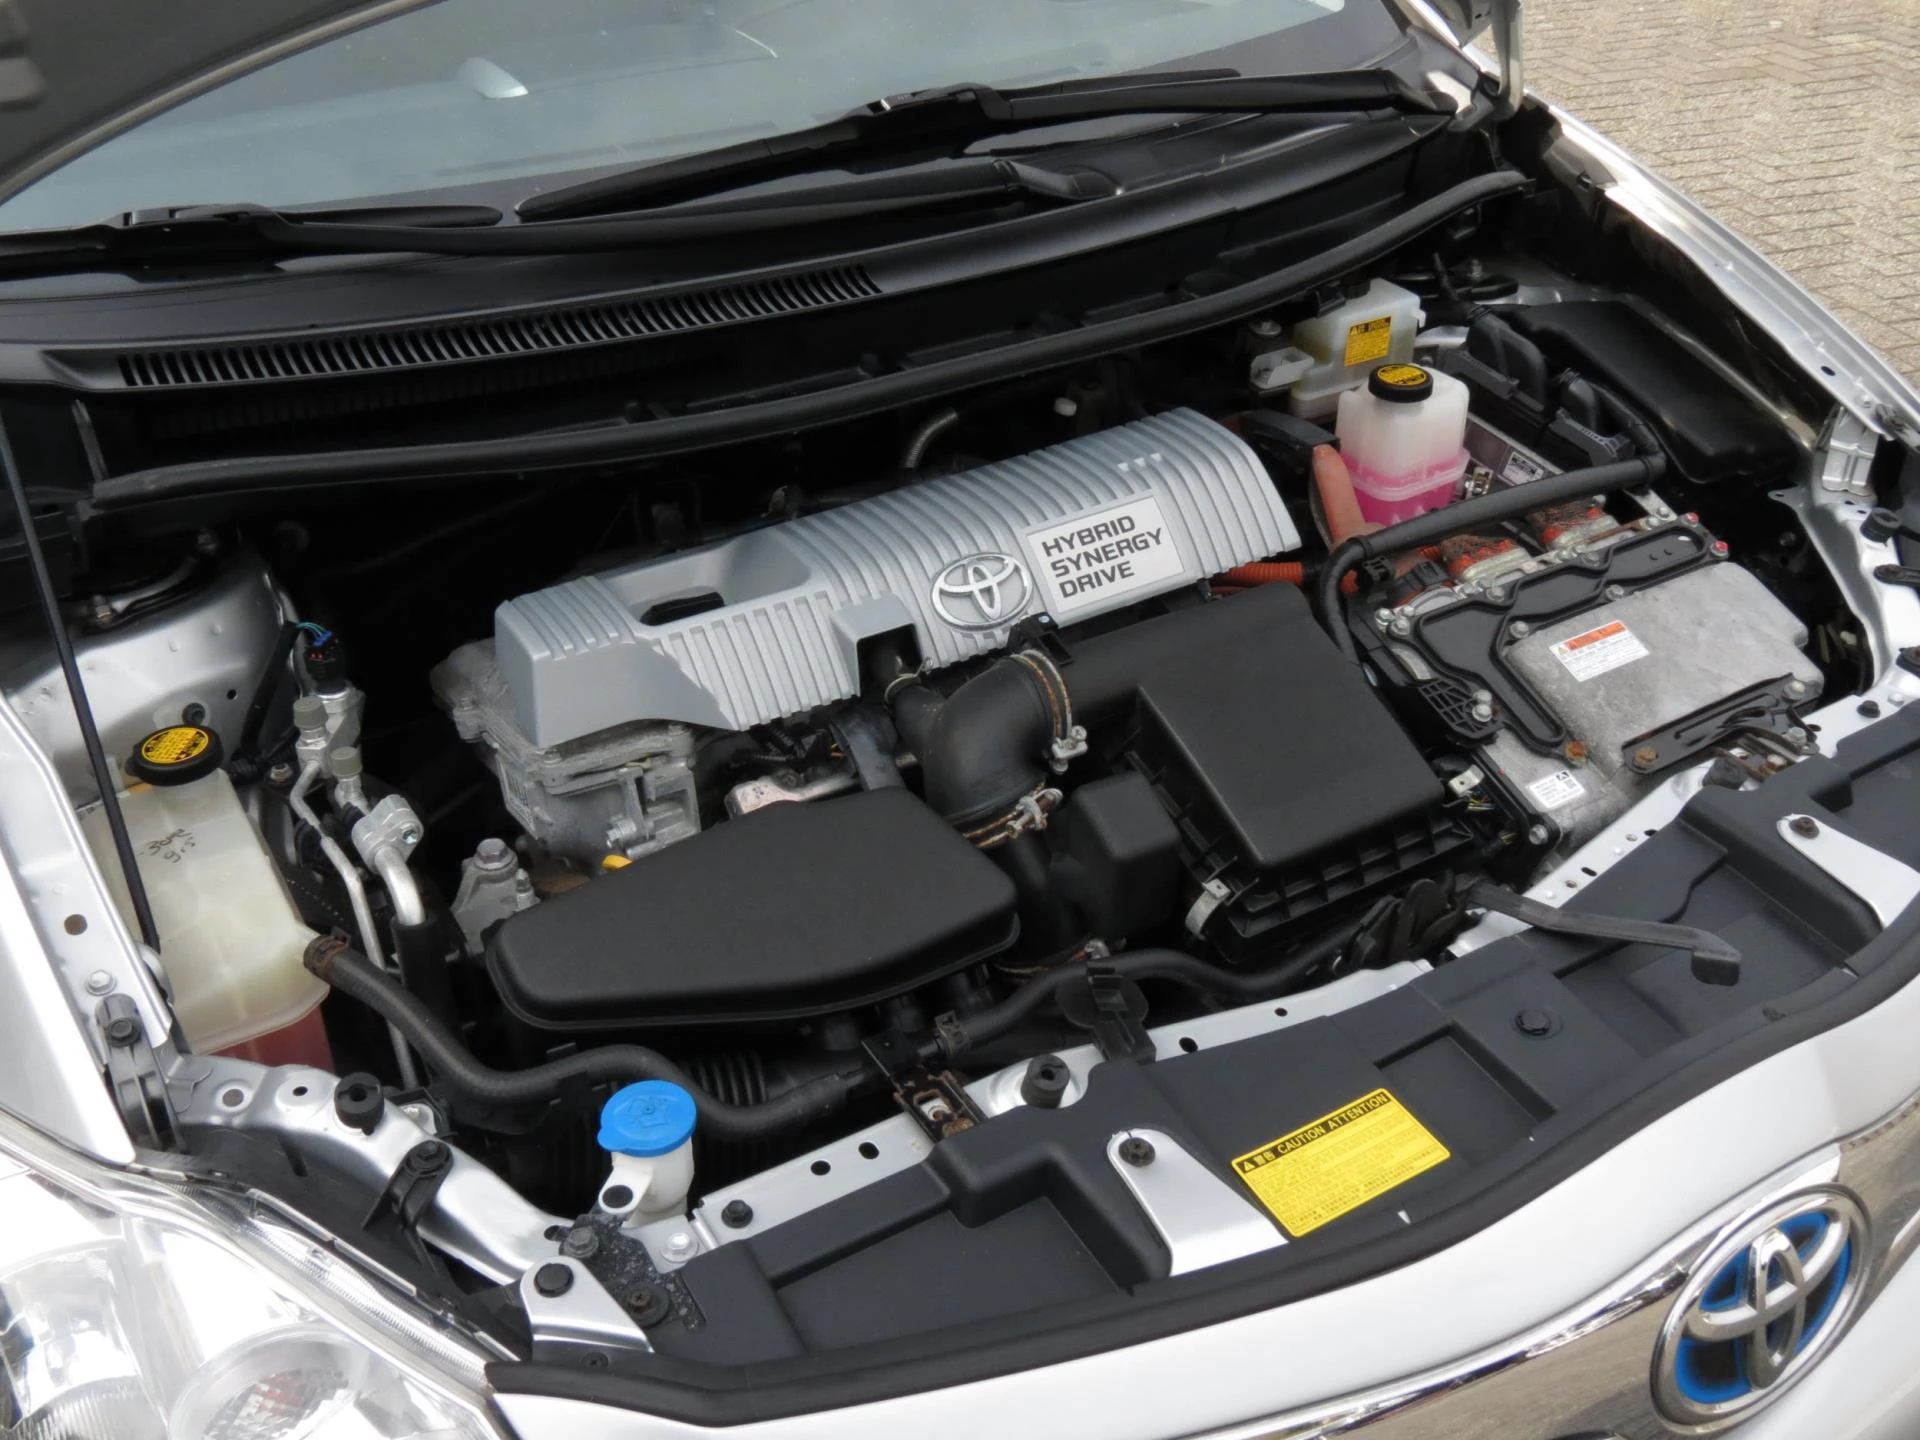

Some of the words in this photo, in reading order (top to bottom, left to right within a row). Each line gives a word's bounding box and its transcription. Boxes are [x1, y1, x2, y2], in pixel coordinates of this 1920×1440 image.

[1042, 515, 1136, 557] HYBRID
[1050, 528, 1162, 578] SYNERGY
[1059, 561, 1135, 598] DRIVE
[1277, 1126, 1326, 1155] CAUTION
[1329, 1093, 1388, 1128] ATTENTION
